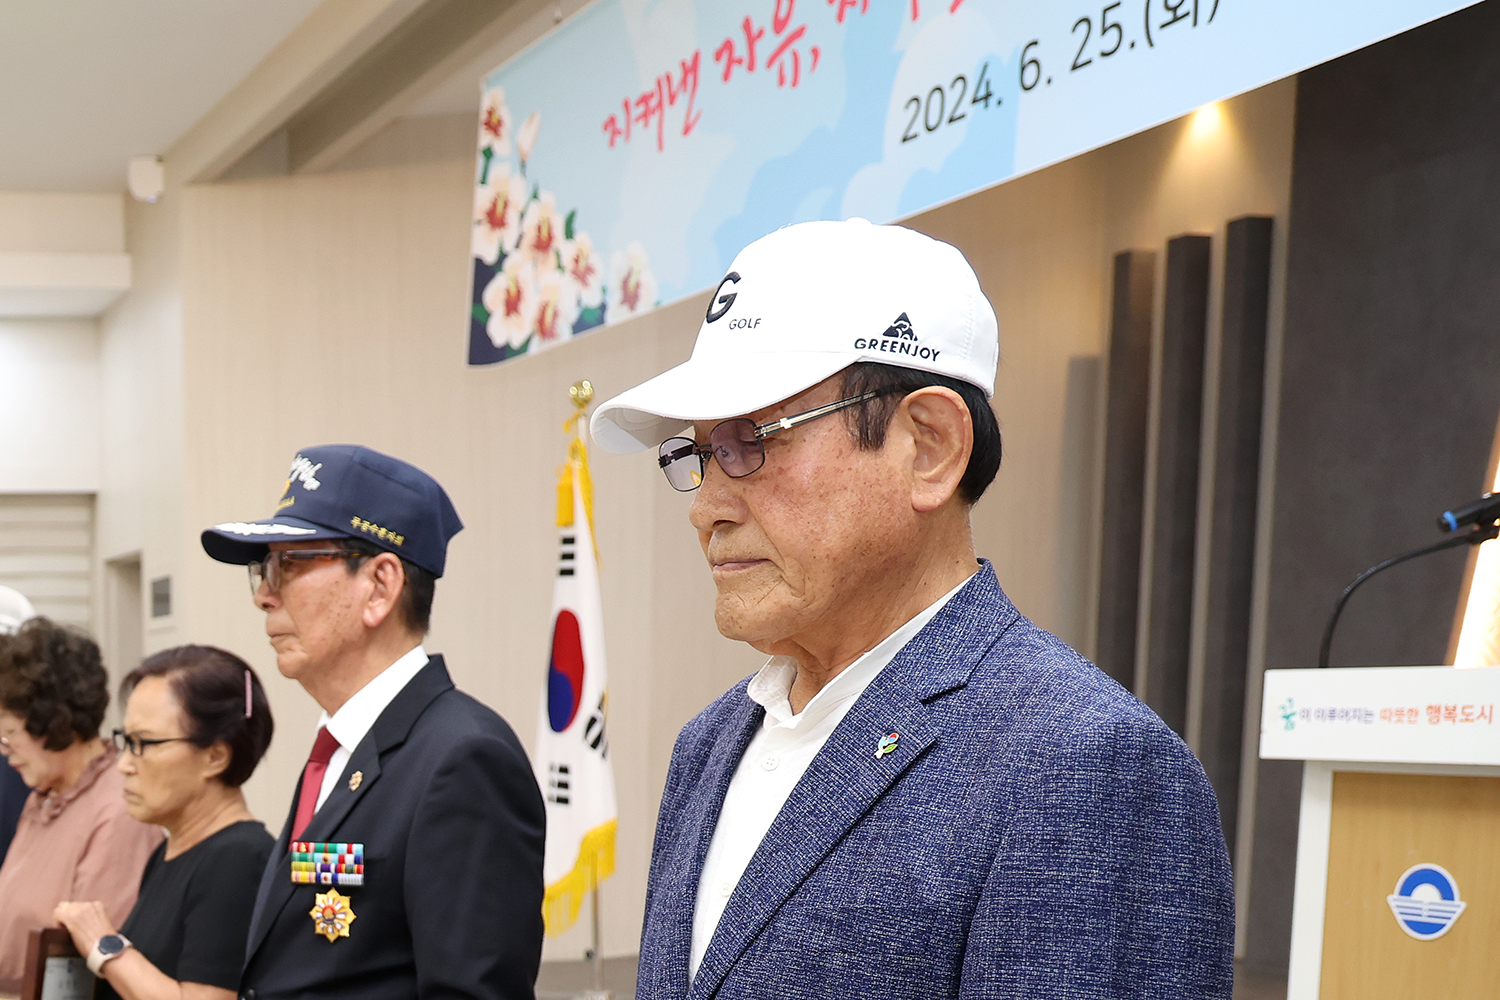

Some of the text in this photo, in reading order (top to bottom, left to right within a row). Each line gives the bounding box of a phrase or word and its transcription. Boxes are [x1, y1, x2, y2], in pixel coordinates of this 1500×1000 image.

[603, 0, 821, 152] 지켜낸 자유,
[900, 62, 1003, 143] 2024.
[1020, 40, 1052, 91] 6.
[706, 271, 742, 324] G
[728, 318, 762, 330] GOLF
[854, 338, 941, 362] GREENJOY
[1380, 708, 1419, 725] 따뜻한
[1427, 703, 1494, 726] 행복도시
